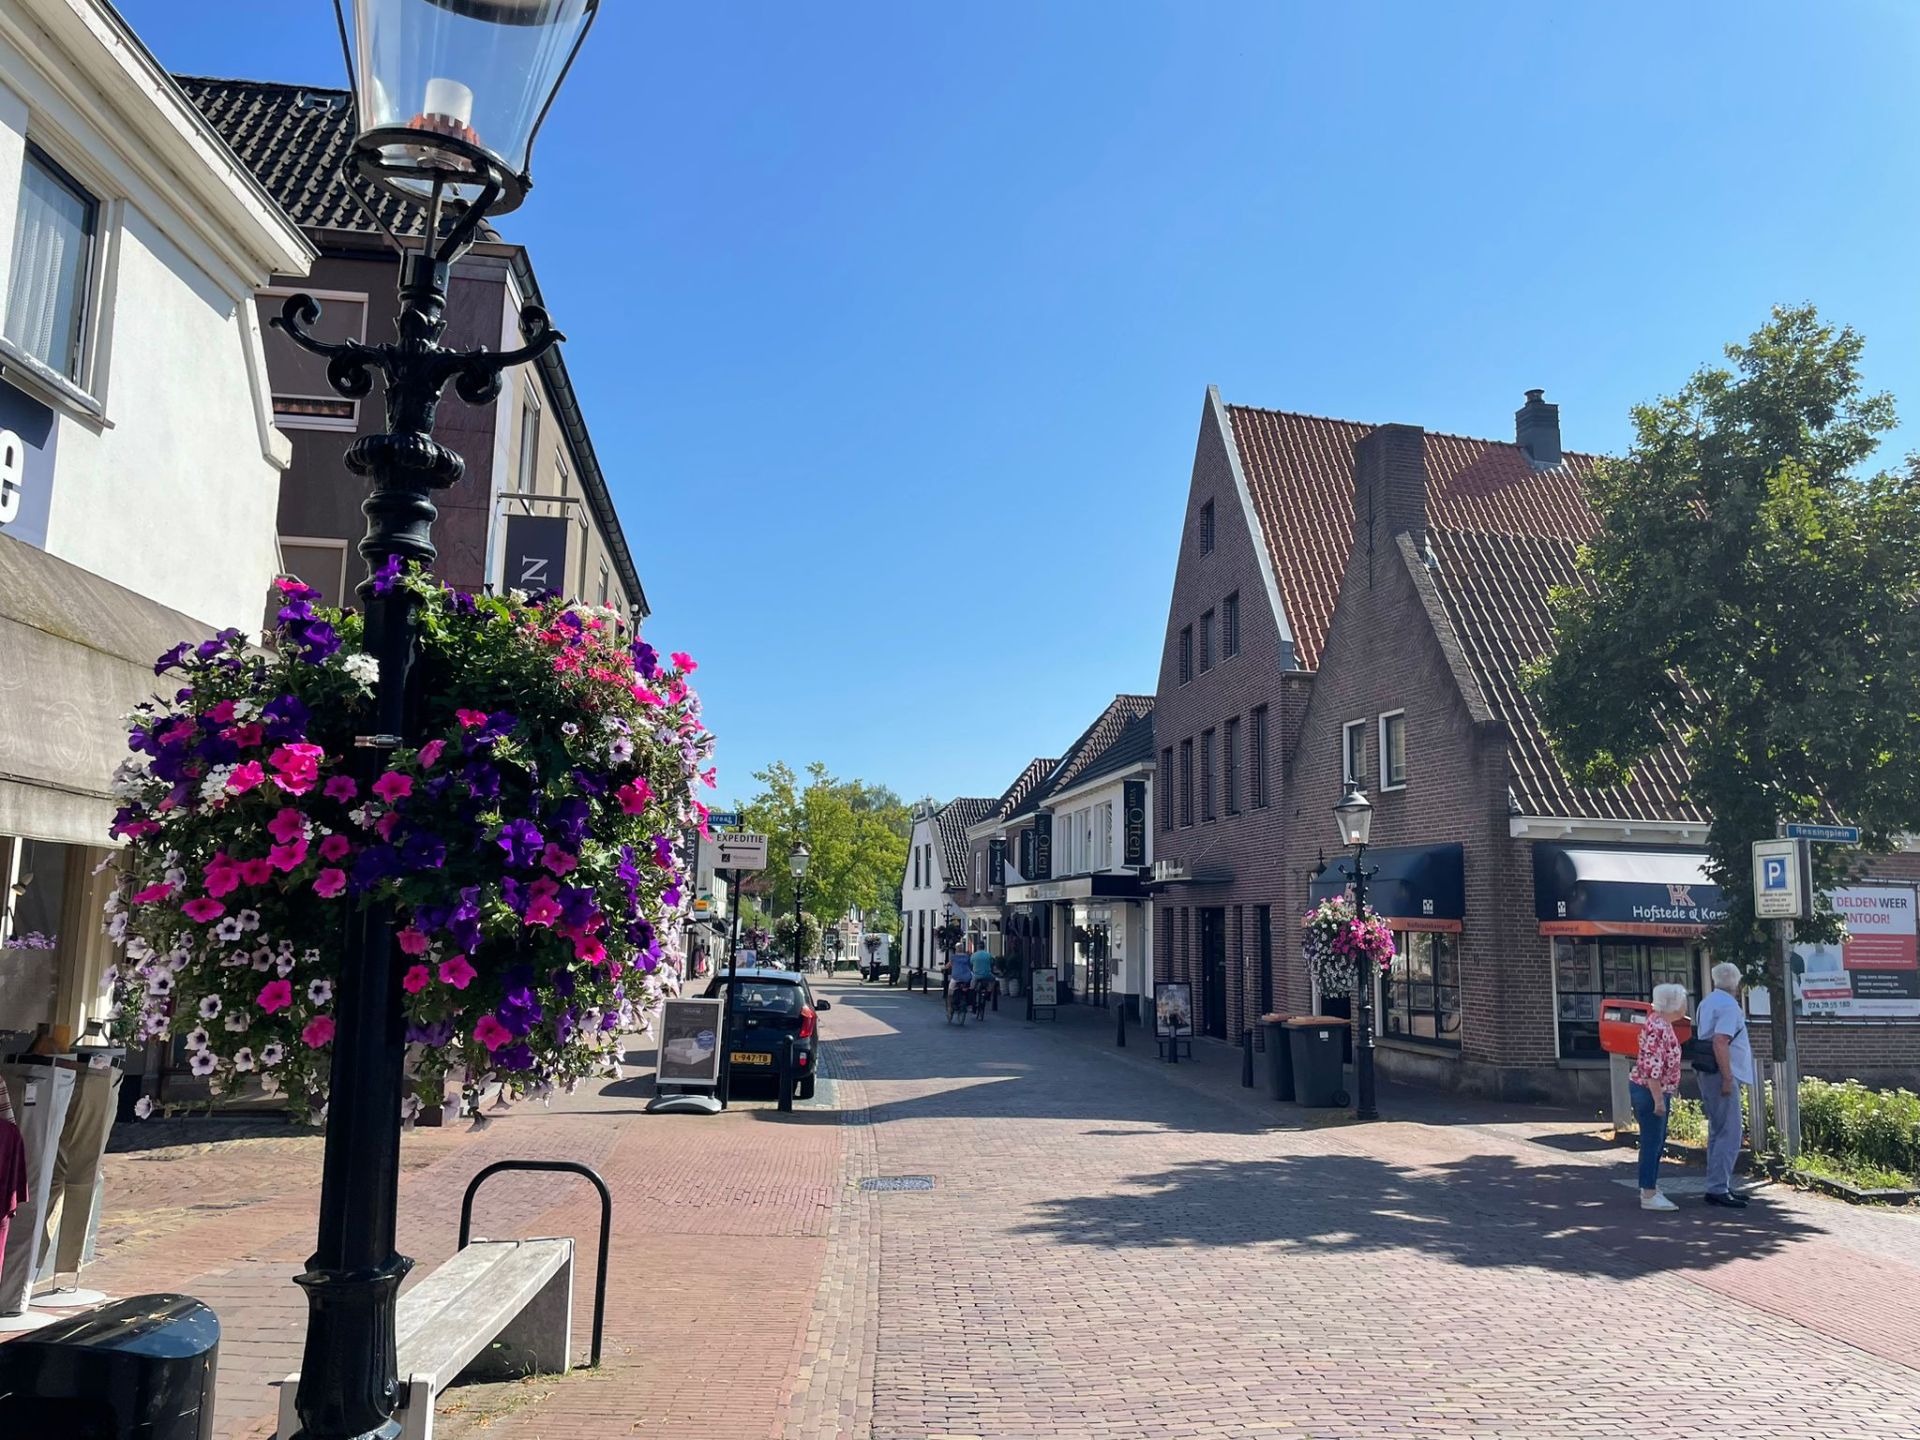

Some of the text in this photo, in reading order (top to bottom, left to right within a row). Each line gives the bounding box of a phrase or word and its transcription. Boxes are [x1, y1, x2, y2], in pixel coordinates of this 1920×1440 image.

[716, 833, 764, 843] EXPEDITIE
[1129, 807, 1145, 858] Otten
[1038, 834, 1051, 874] Otten
[1768, 861, 1781, 886] P
[1836, 896, 1877, 908] DELDEN
[1879, 897, 1907, 909] WEER
[1632, 905, 1686, 921] Hofstede
[1843, 912, 1890, 924] ANTOOR!
